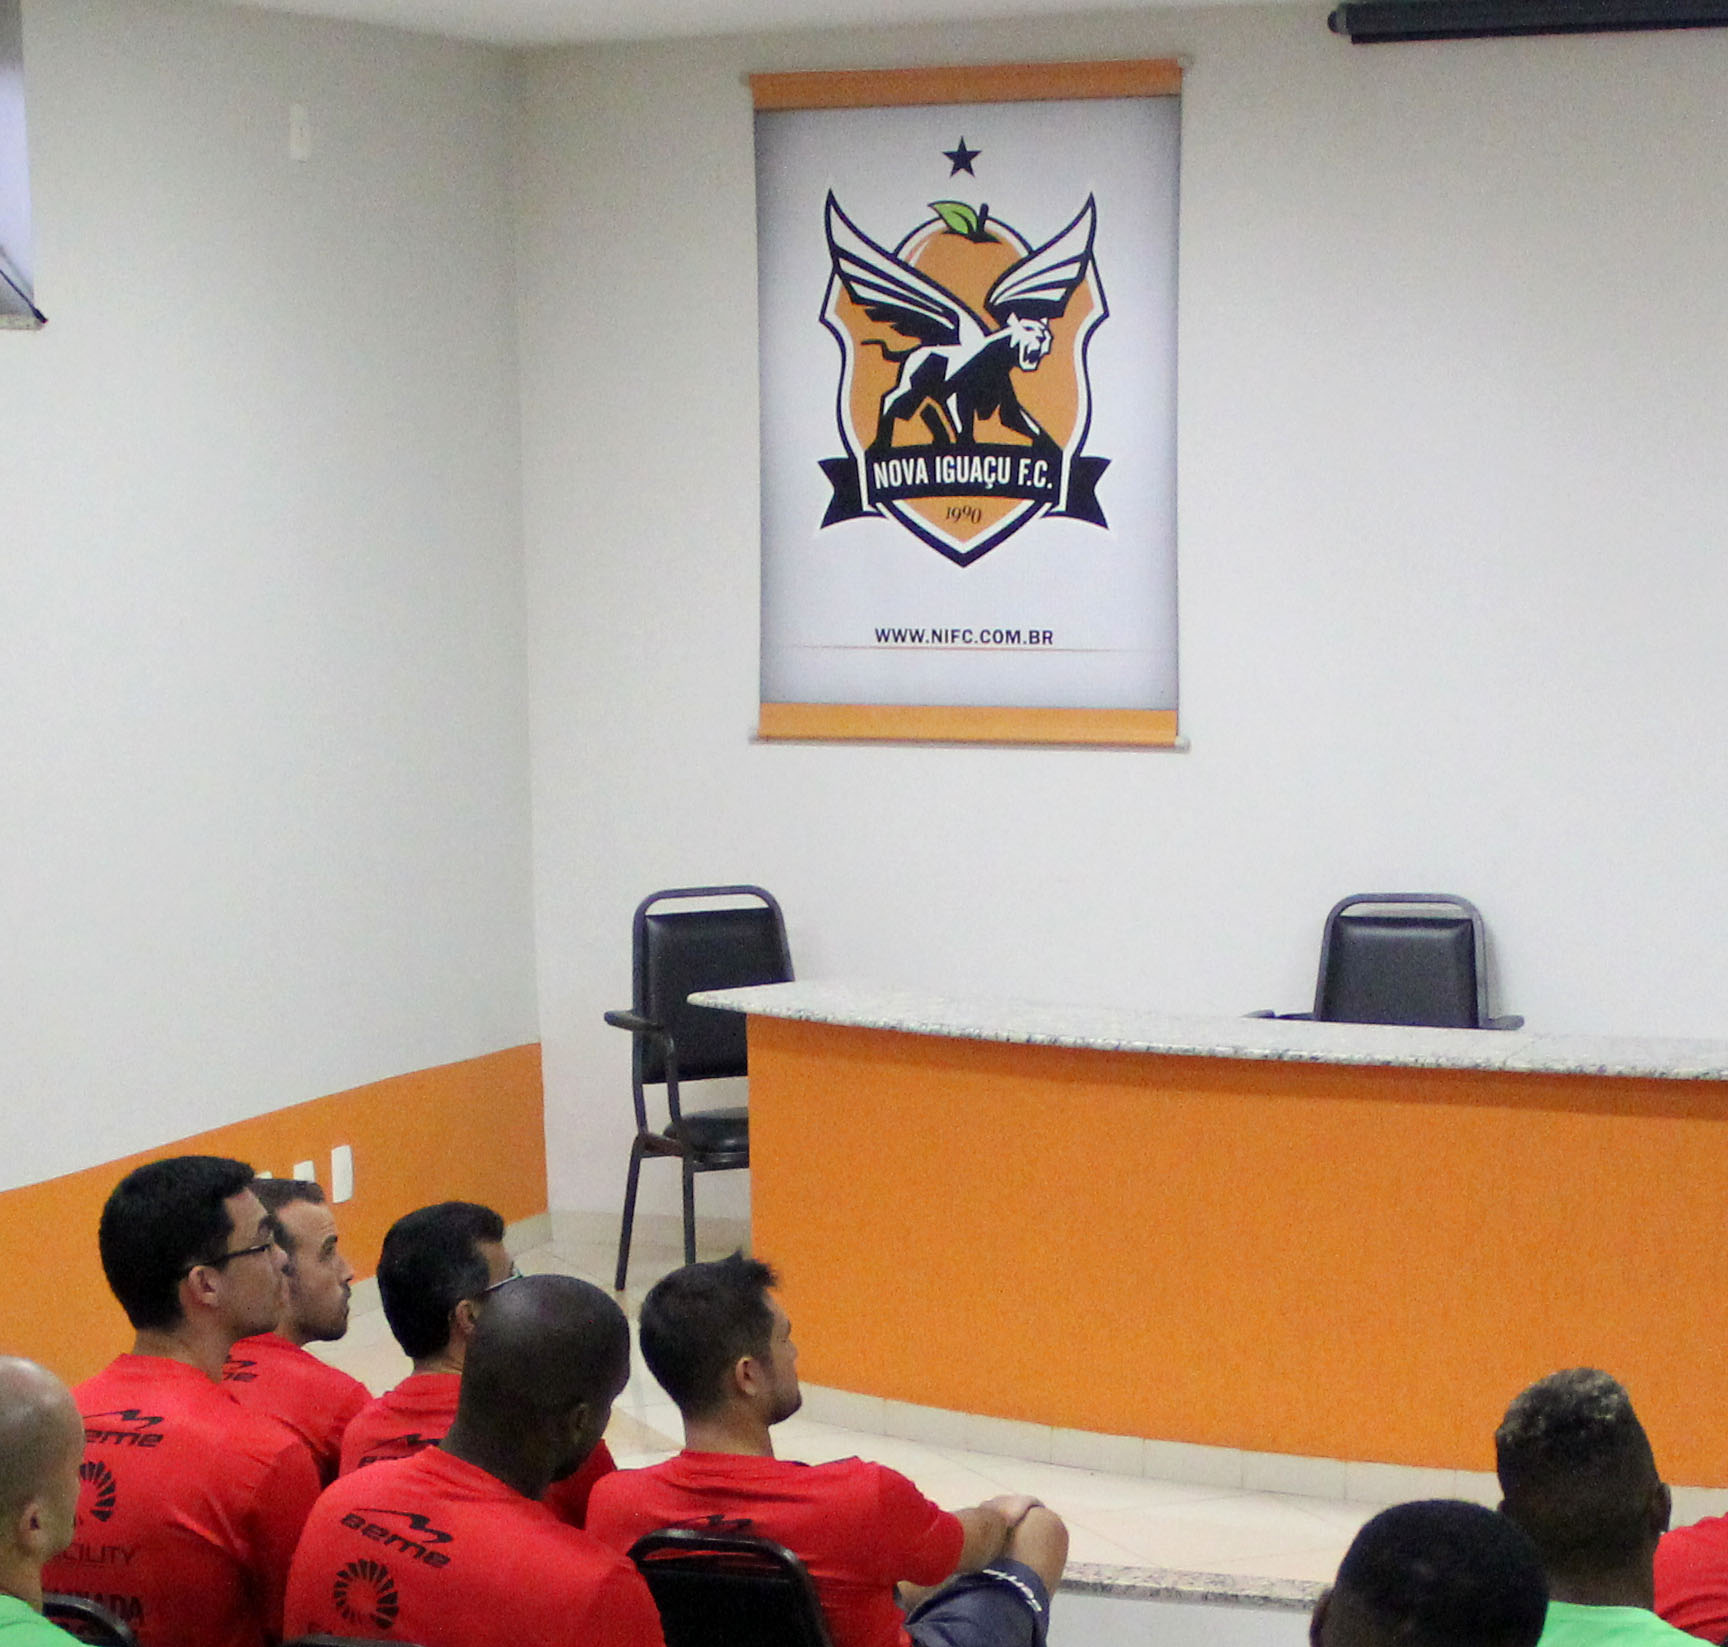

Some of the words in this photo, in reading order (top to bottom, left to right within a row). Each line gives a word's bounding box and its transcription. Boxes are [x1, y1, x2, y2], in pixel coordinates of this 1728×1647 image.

[873, 458, 929, 490] NOVA
[935, 455, 1012, 490] IGUAÇU
[1017, 458, 1054, 490] F.C.
[945, 504, 983, 525] 1990
[874, 627, 1054, 646] WWW.NIFC.COM.BR
